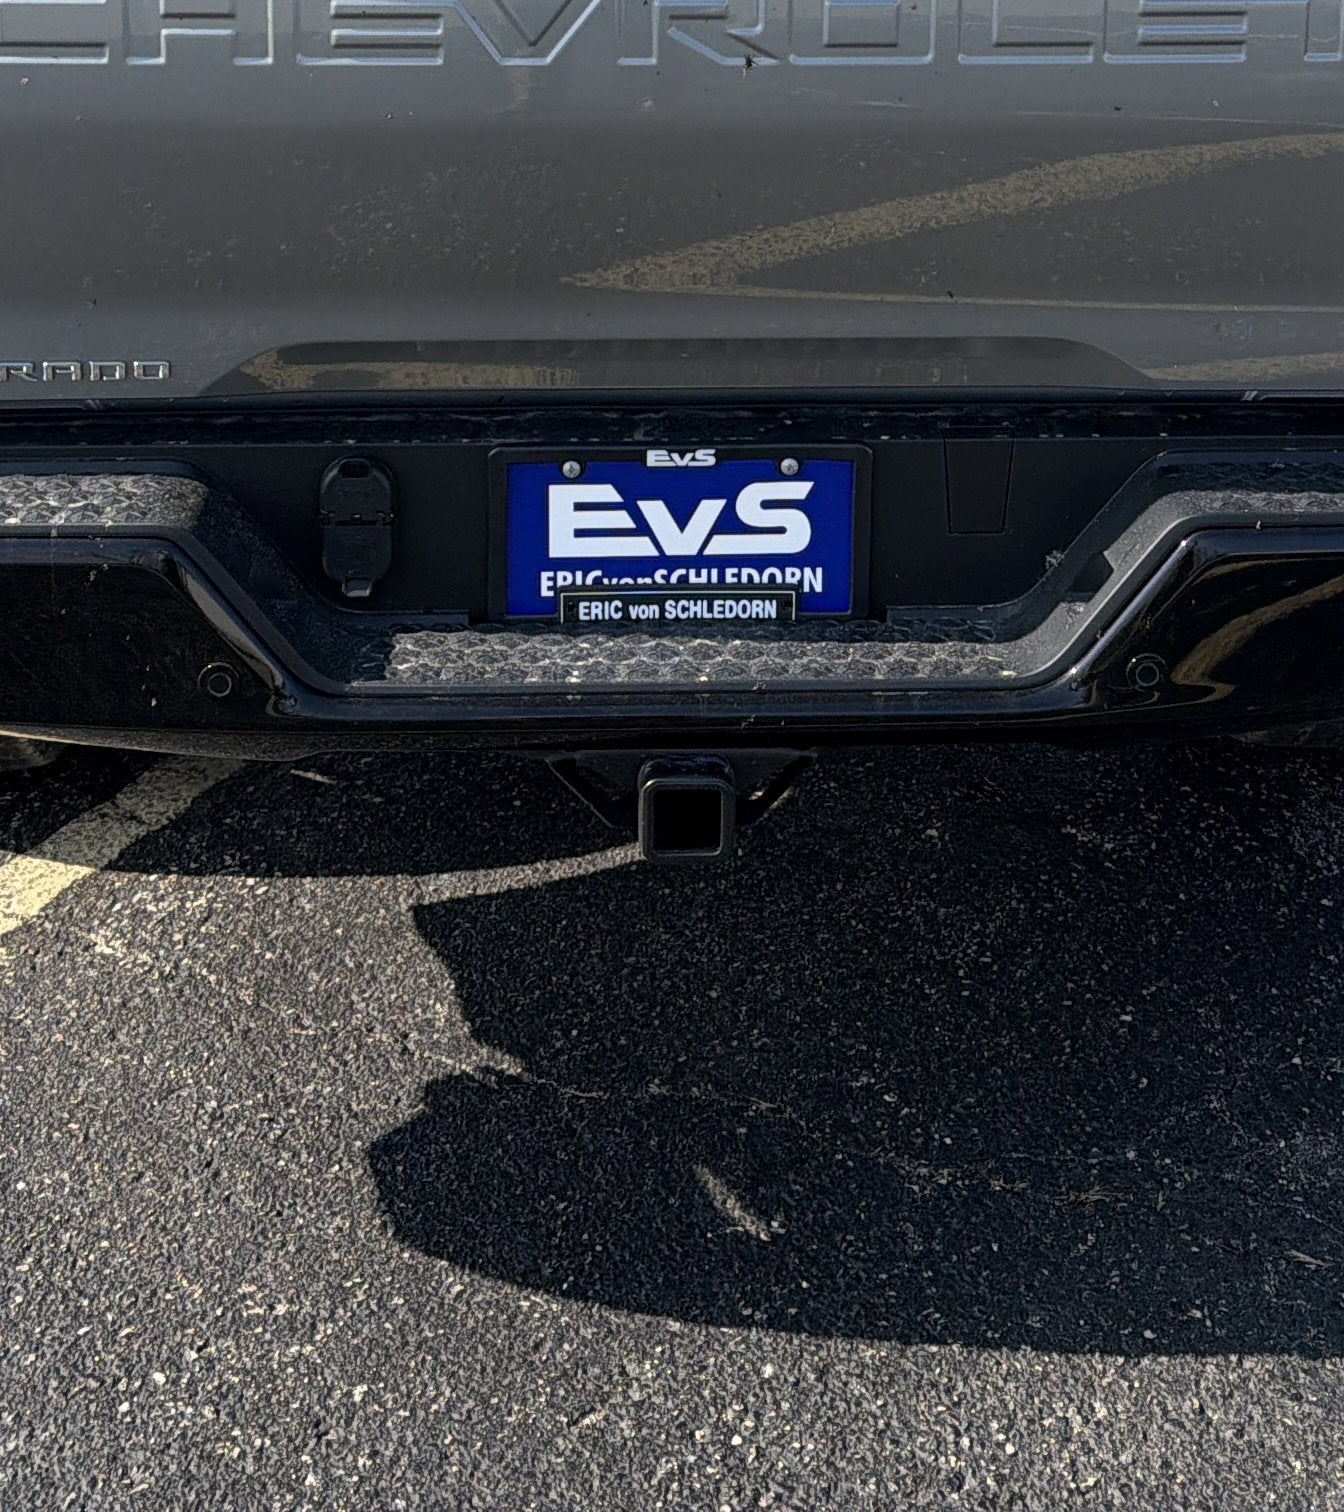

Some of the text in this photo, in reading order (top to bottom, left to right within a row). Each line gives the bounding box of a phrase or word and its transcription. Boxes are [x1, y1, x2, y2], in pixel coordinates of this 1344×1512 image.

[578, 599, 777, 621] ERIC von SCHLEDORN
